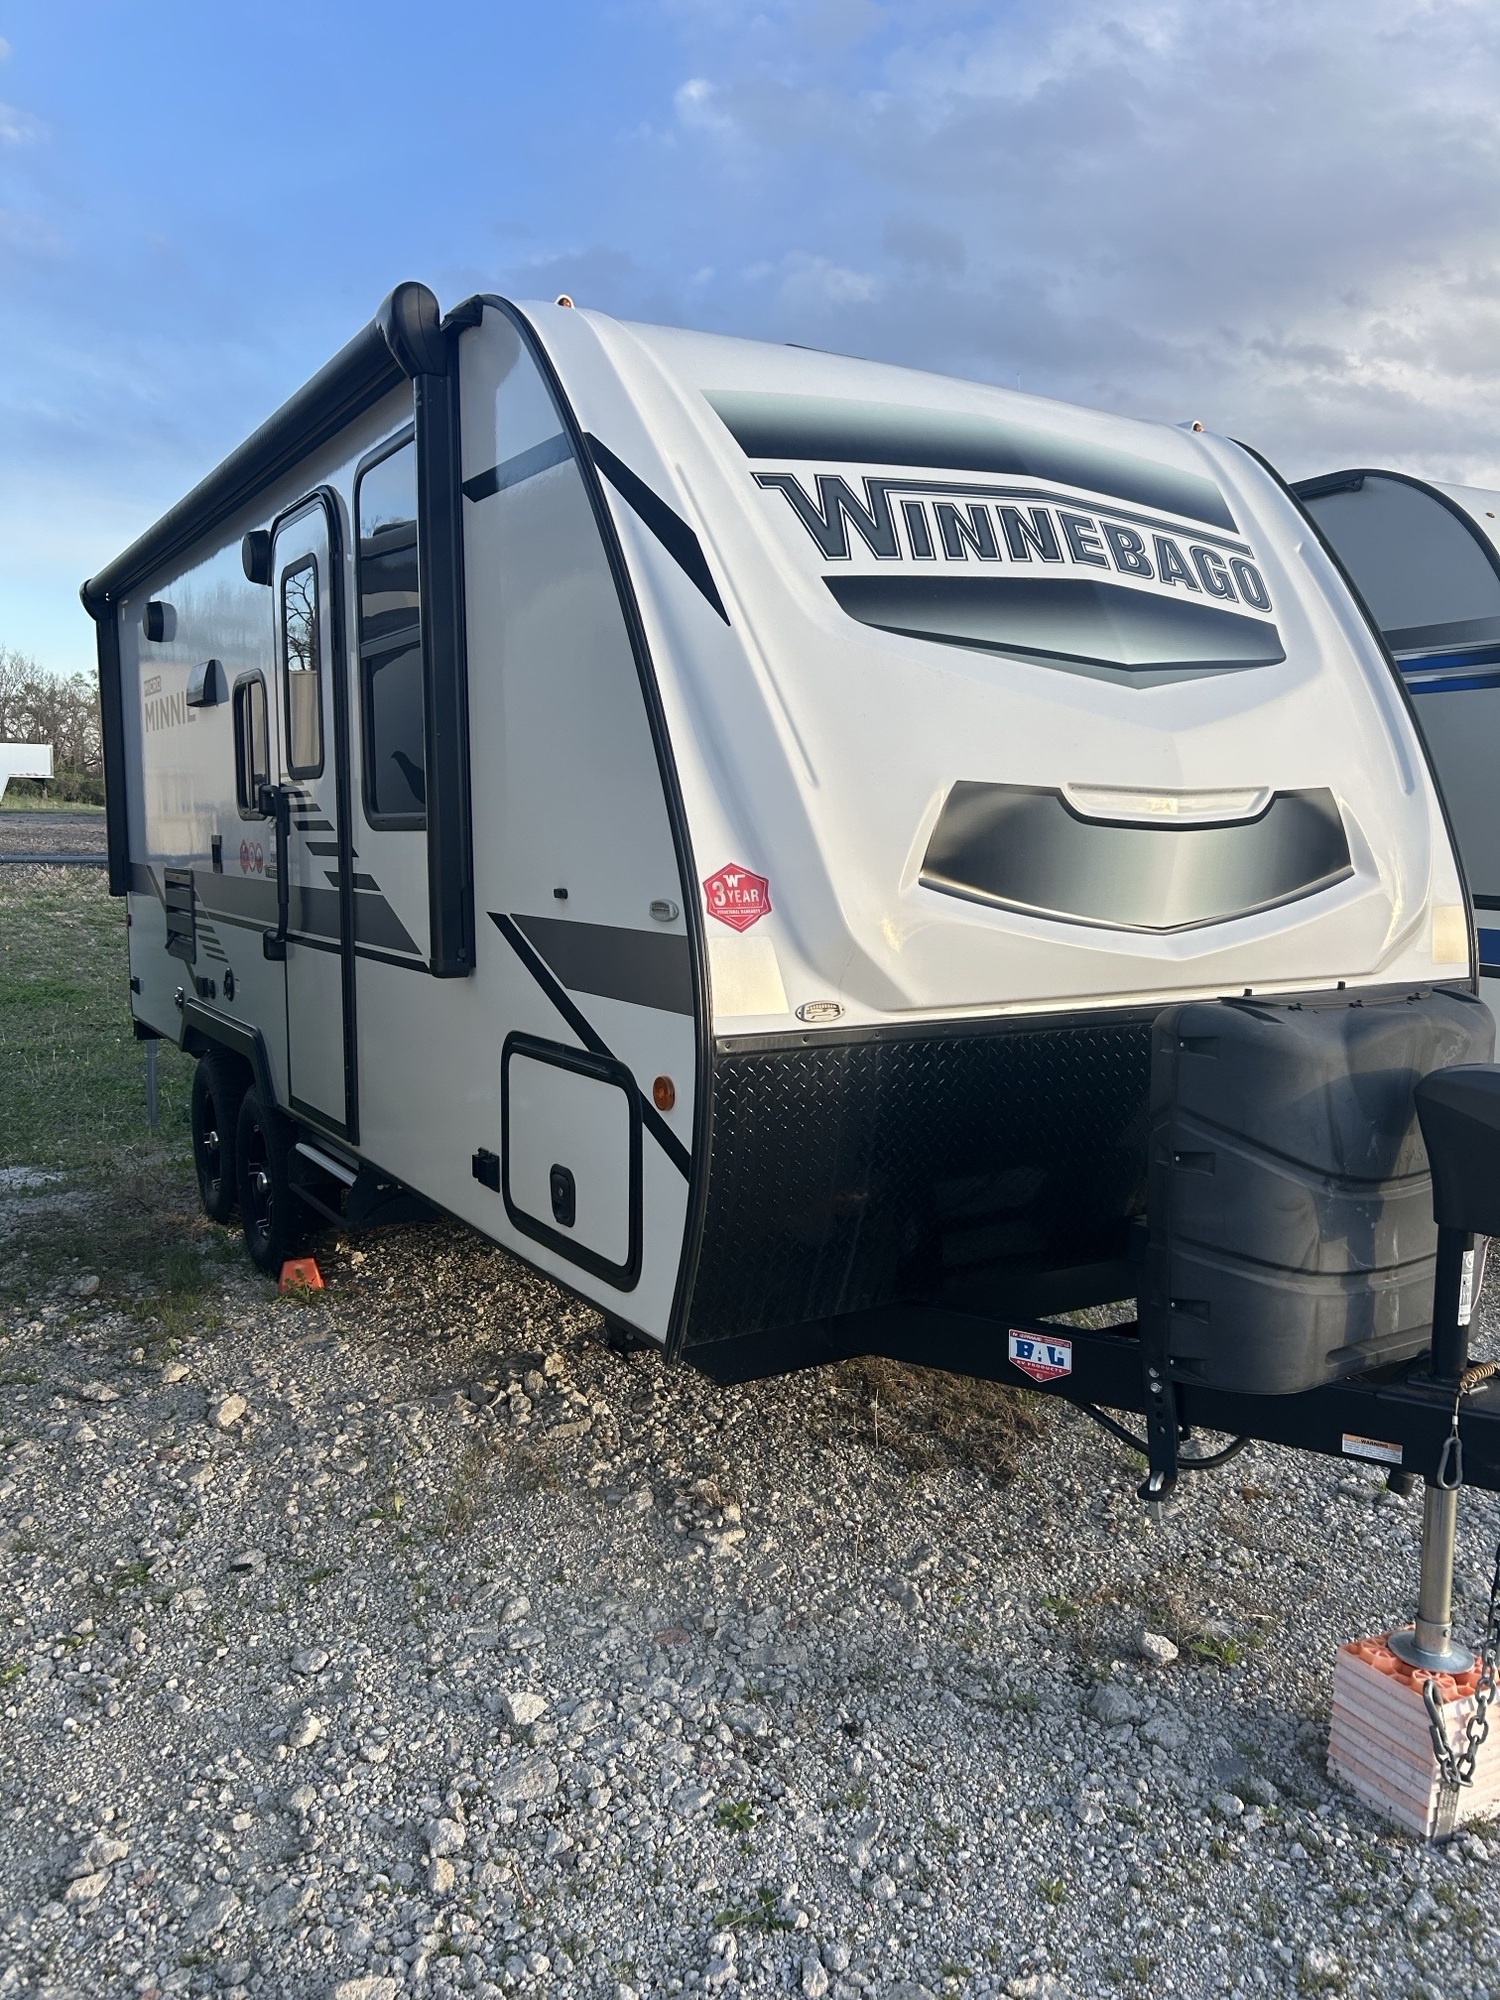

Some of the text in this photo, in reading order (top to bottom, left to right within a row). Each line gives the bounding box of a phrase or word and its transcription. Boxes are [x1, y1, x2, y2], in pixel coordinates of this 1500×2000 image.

[749, 471, 1273, 613] WINNEBAGO
[712, 881, 759, 906] 3 YEAR
[1360, 1439, 1389, 1449] WARNING
